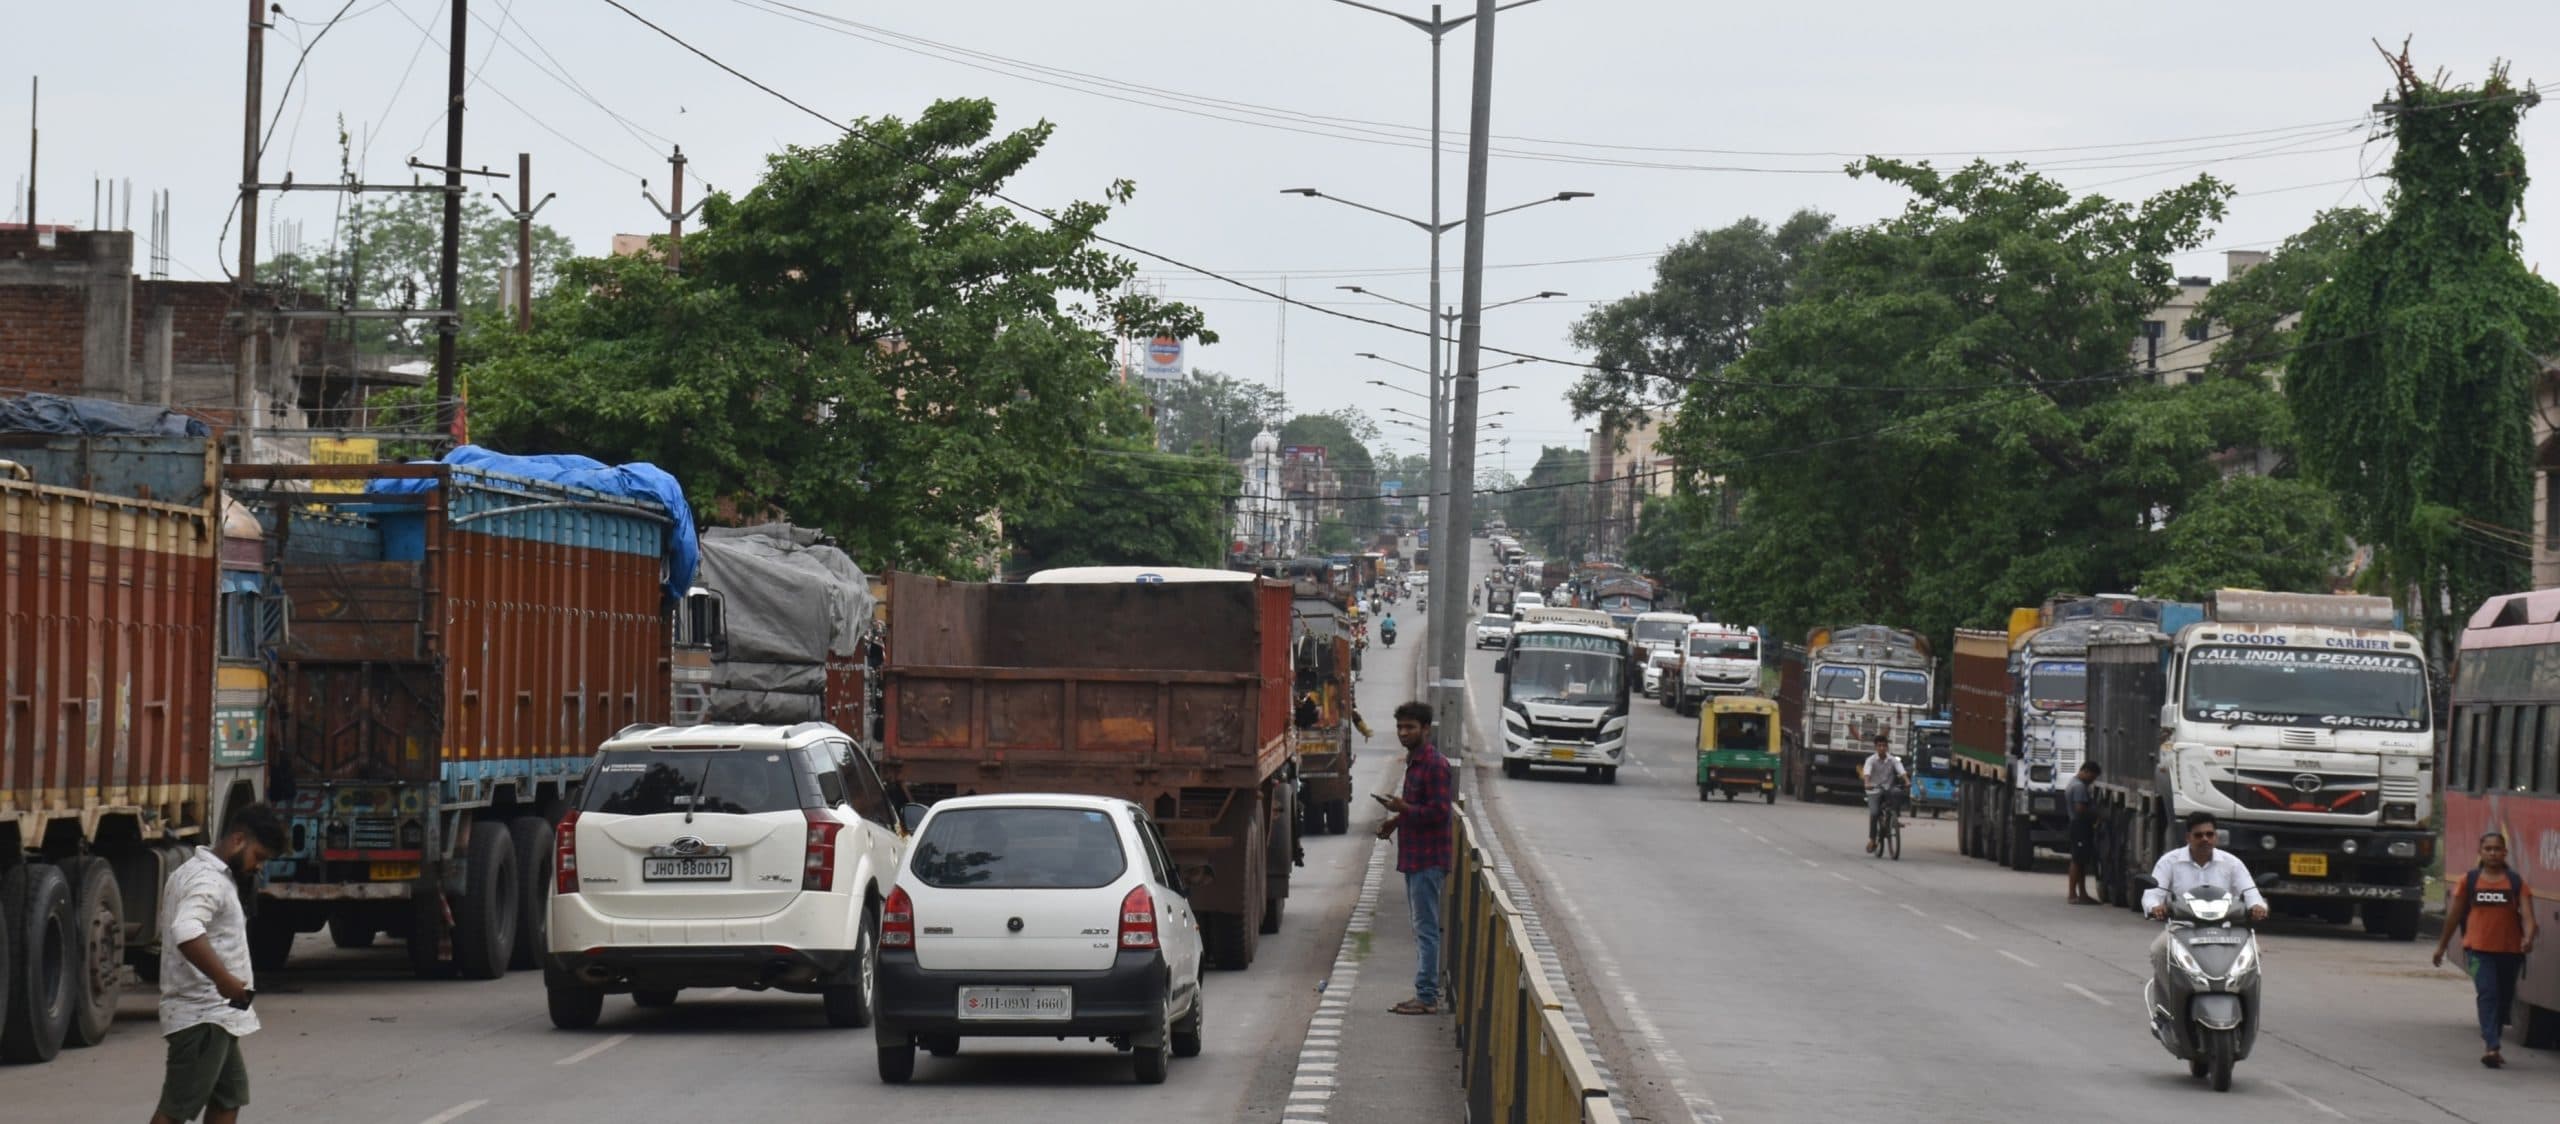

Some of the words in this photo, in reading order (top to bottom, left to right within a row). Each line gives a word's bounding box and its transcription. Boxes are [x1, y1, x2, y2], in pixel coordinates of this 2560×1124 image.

[1520, 635, 1547, 648] ZEE
[1552, 635, 1620, 652] TRAVELS
[2222, 633, 2287, 646] GOODS
[2326, 637, 2389, 650] CARRIER
[2207, 649, 2239, 660] ALL
[2246, 650, 2296, 662] INDIA
[2315, 653, 2405, 668] PERMIT
[2320, 715, 2409, 728] GARIMA
[2294, 760, 2321, 768] TATA
[2476, 892, 2508, 902] COOL
[1036, 999, 1064, 1009] 4660
